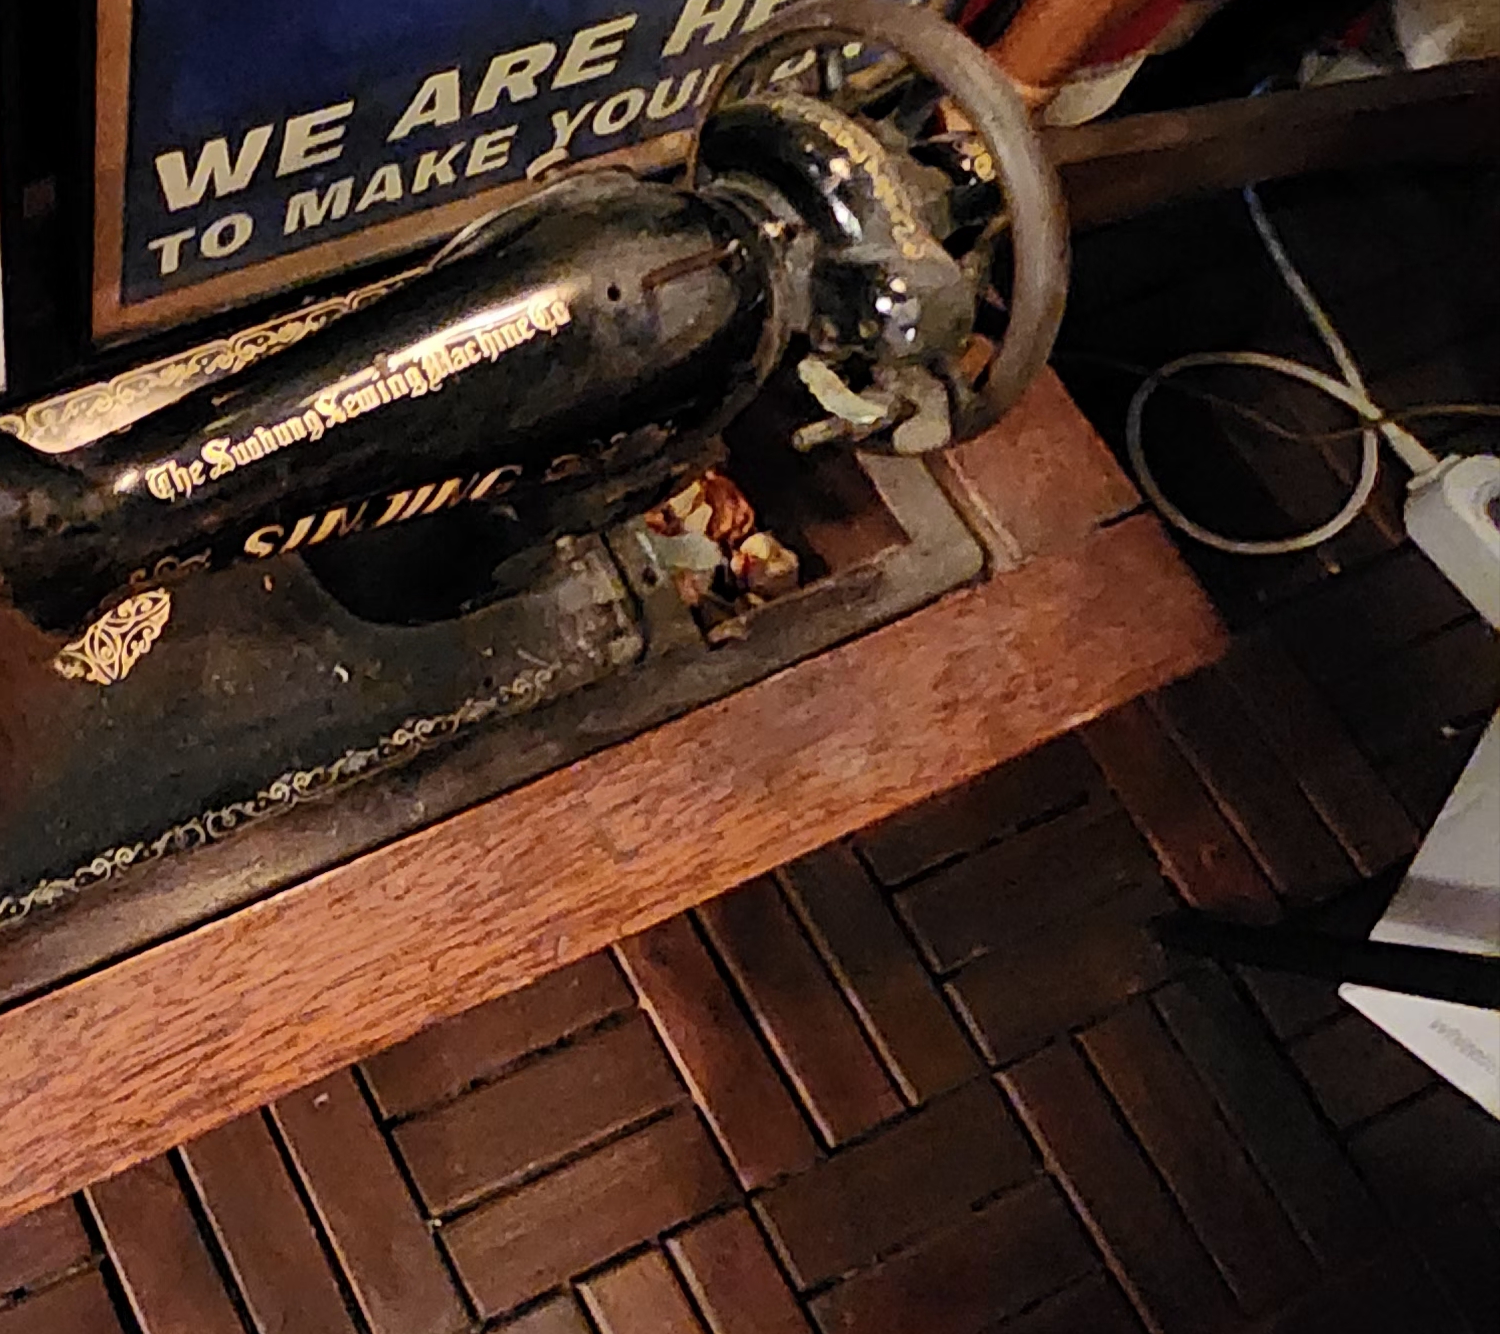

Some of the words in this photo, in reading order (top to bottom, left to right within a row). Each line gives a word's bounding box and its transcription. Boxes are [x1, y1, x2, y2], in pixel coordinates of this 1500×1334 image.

[154, 100, 355, 212] WE
[387, 13, 637, 143] ARE
[148, 213, 254, 276] TO
[283, 124, 519, 236] MAKE
[144, 459, 206, 502] The
